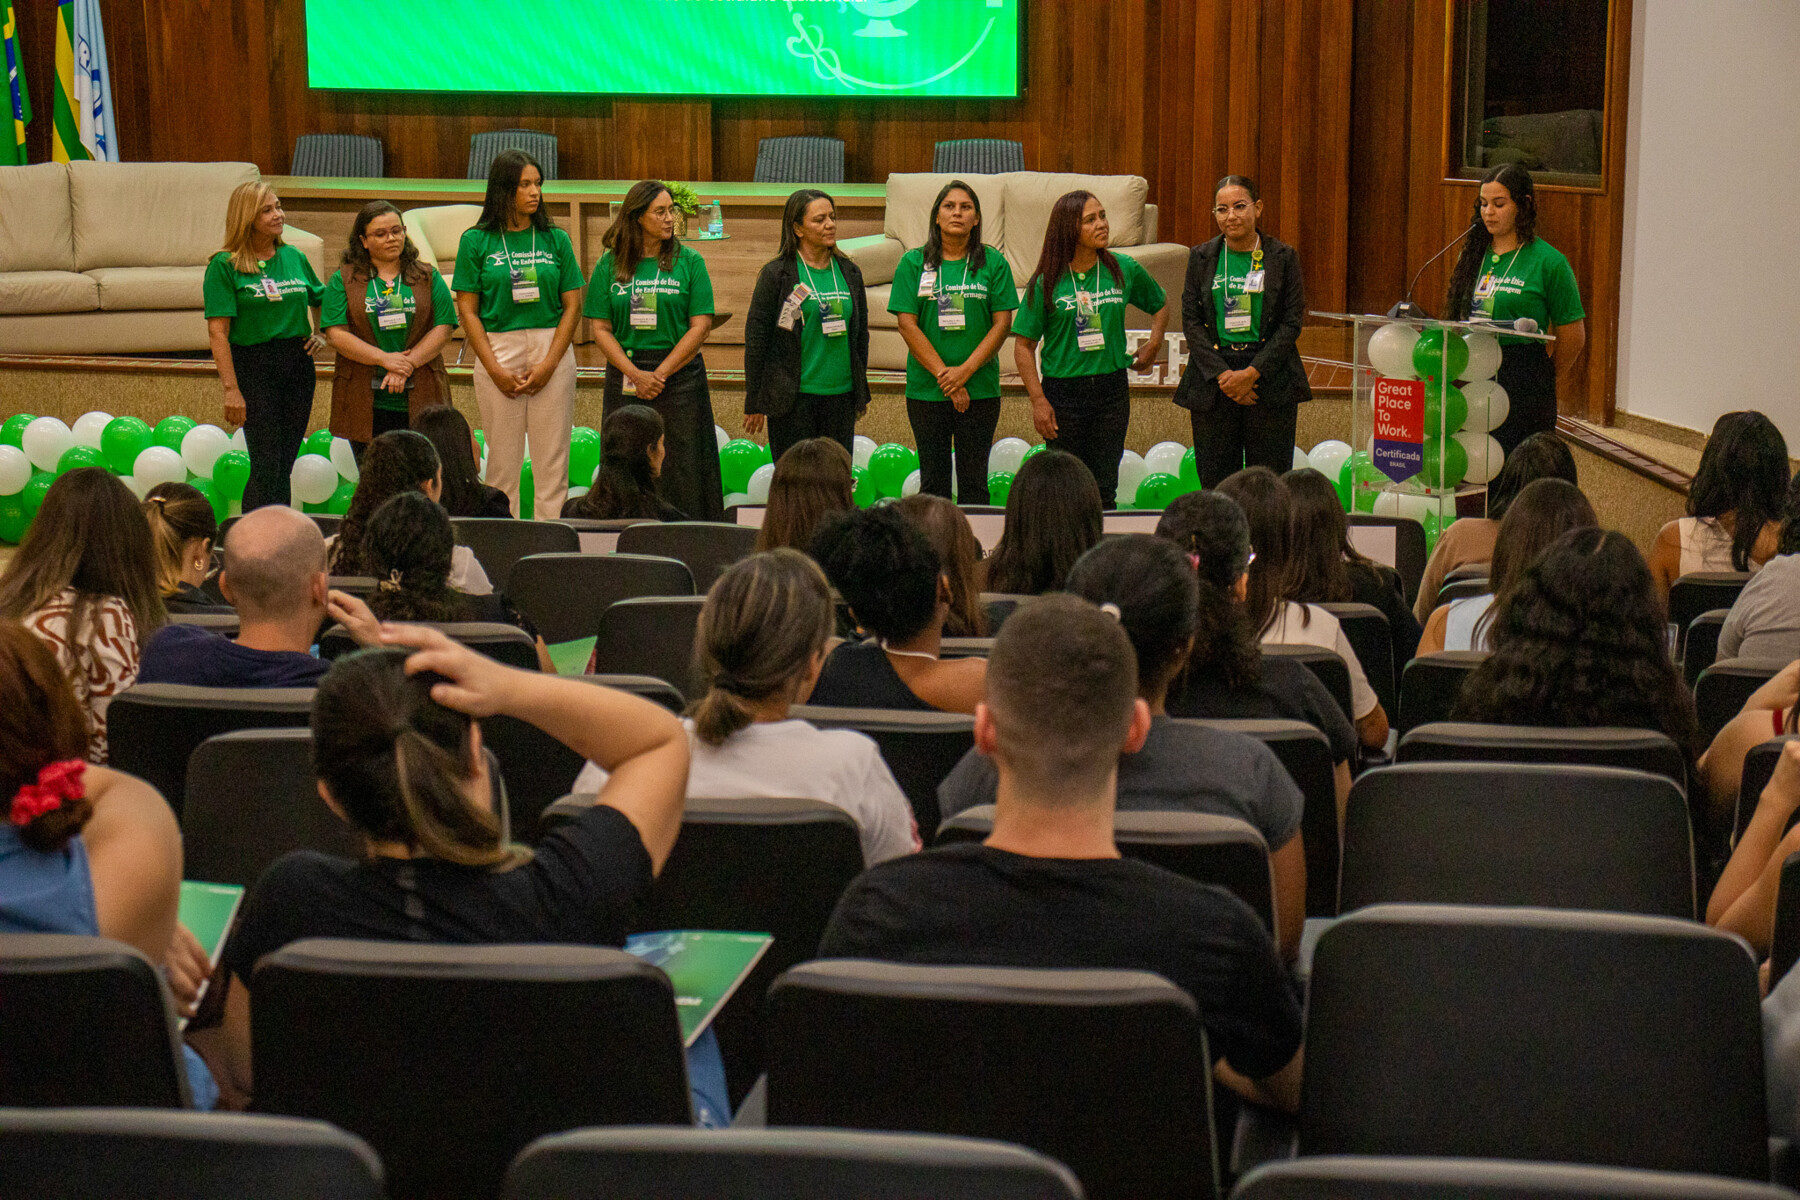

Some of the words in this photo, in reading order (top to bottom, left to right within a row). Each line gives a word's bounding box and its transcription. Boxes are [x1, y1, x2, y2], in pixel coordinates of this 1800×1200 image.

[667, 277, 681, 287] Ética
[1510, 276, 1525, 287] Ética
[643, 286, 680, 295] Enfermagem
[1378, 381, 1412, 397] Great
[1378, 395, 1412, 410] Place
[1378, 408, 1391, 422] To
[1375, 448, 1421, 461] Certificada
[1389, 461, 1406, 469] BRASIL
